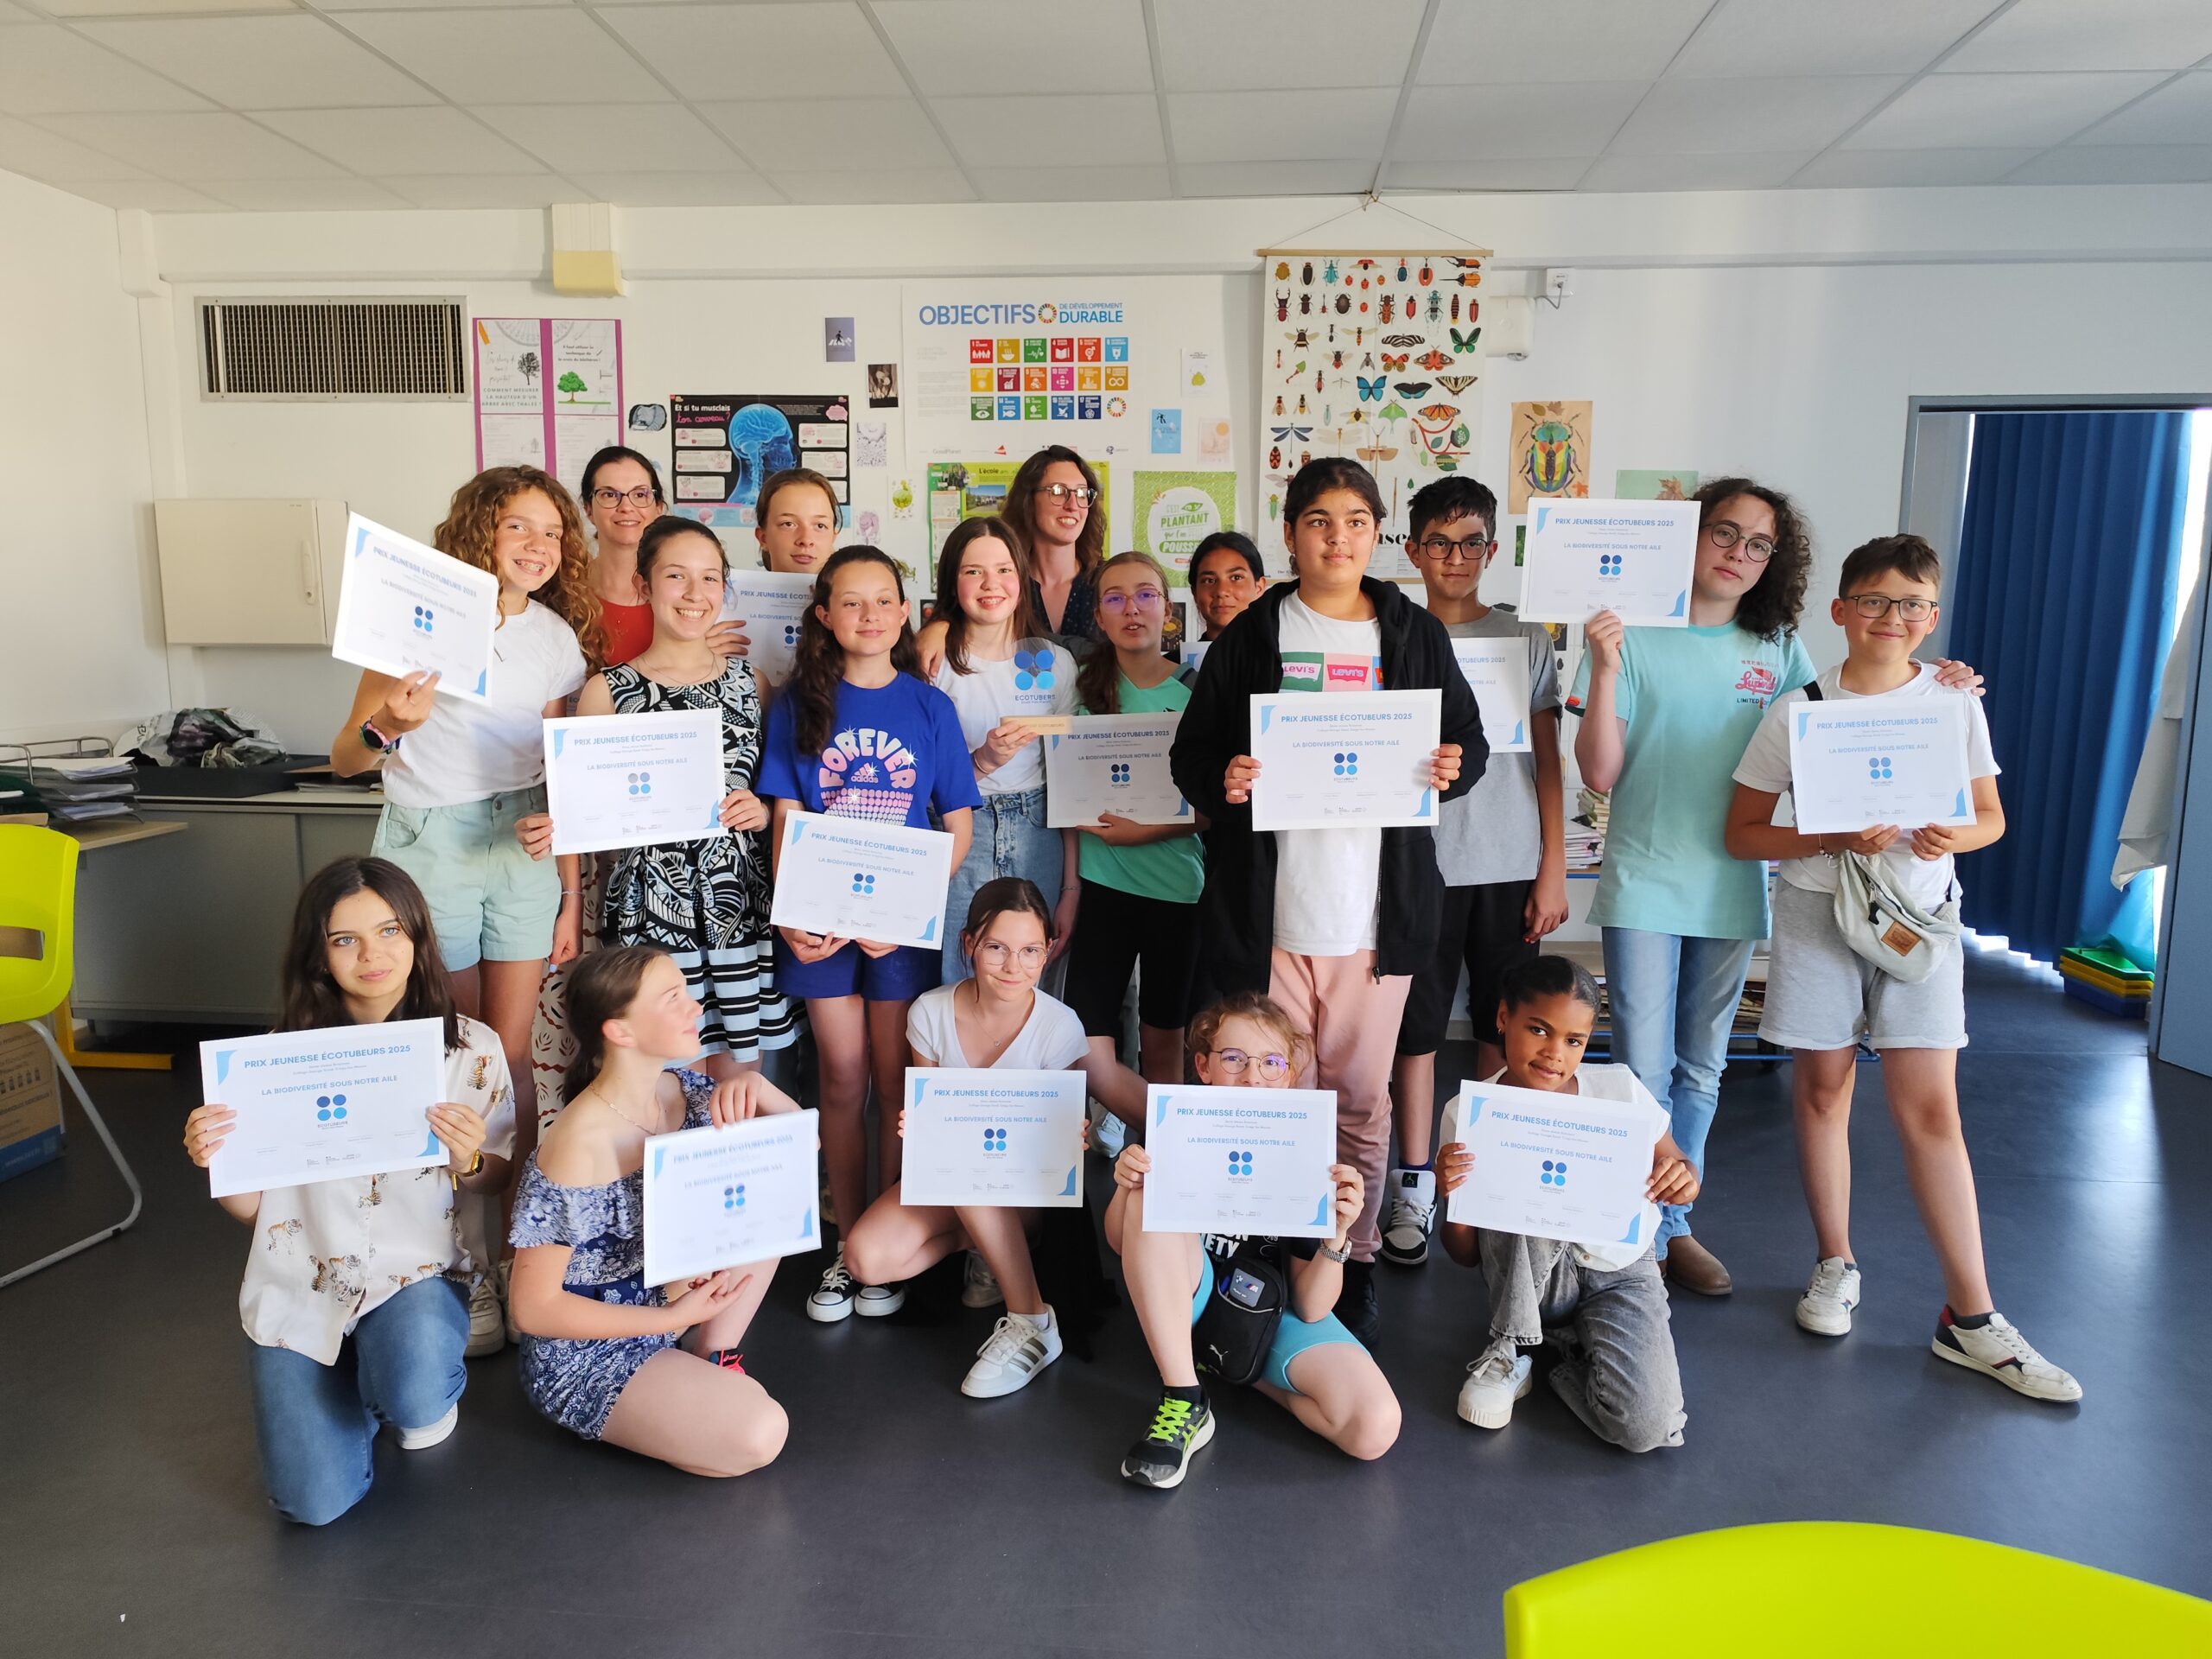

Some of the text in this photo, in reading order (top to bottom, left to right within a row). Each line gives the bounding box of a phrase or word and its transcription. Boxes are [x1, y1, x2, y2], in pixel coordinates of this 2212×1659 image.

[918, 303, 1036, 325] OBJECTIFS
[1059, 310, 1122, 323] DURABLE
[1161, 513, 1209, 527] PLANTANT
[1609, 518, 1655, 526] ÉCOTUBEURS
[593, 736, 630, 745] JEUNESSE
[631, 733, 678, 742] ÉCOTUBEURS
[819, 728, 916, 789] FOREVER
[850, 775, 878, 784] adidas
[829, 836, 862, 846] JEUNESSE
[864, 839, 910, 854] ÉCOTUBEURS
[911, 848, 928, 856] 2025
[245, 1059, 267, 1068] PRIX
[269, 1054, 319, 1065] JEUNESSE
[321, 1047, 386, 1060] ÉCOTUBEURS
[388, 1045, 411, 1054] 2025
[274, 1082, 327, 1094] BIODIVERSITÉ
[329, 1080, 353, 1089] SOUS
[354, 1077, 379, 1086] NOTRE
[991, 1089, 1039, 1097] ÉCOTUBEURS
[1236, 1109, 1287, 1118] ÉCOTUBEURS
[1491, 1111, 1510, 1121] PRIX
[1511, 1114, 1551, 1126] JEUNESSE
[1553, 1118, 1606, 1134] ÉCOTUBEURS
[1608, 1128, 1628, 1137] 2025
[1510, 1142, 1554, 1154] BIODIVERSITÉ
[1555, 1148, 1573, 1157] SOUS
[1575, 1151, 1597, 1160] NOTRE
